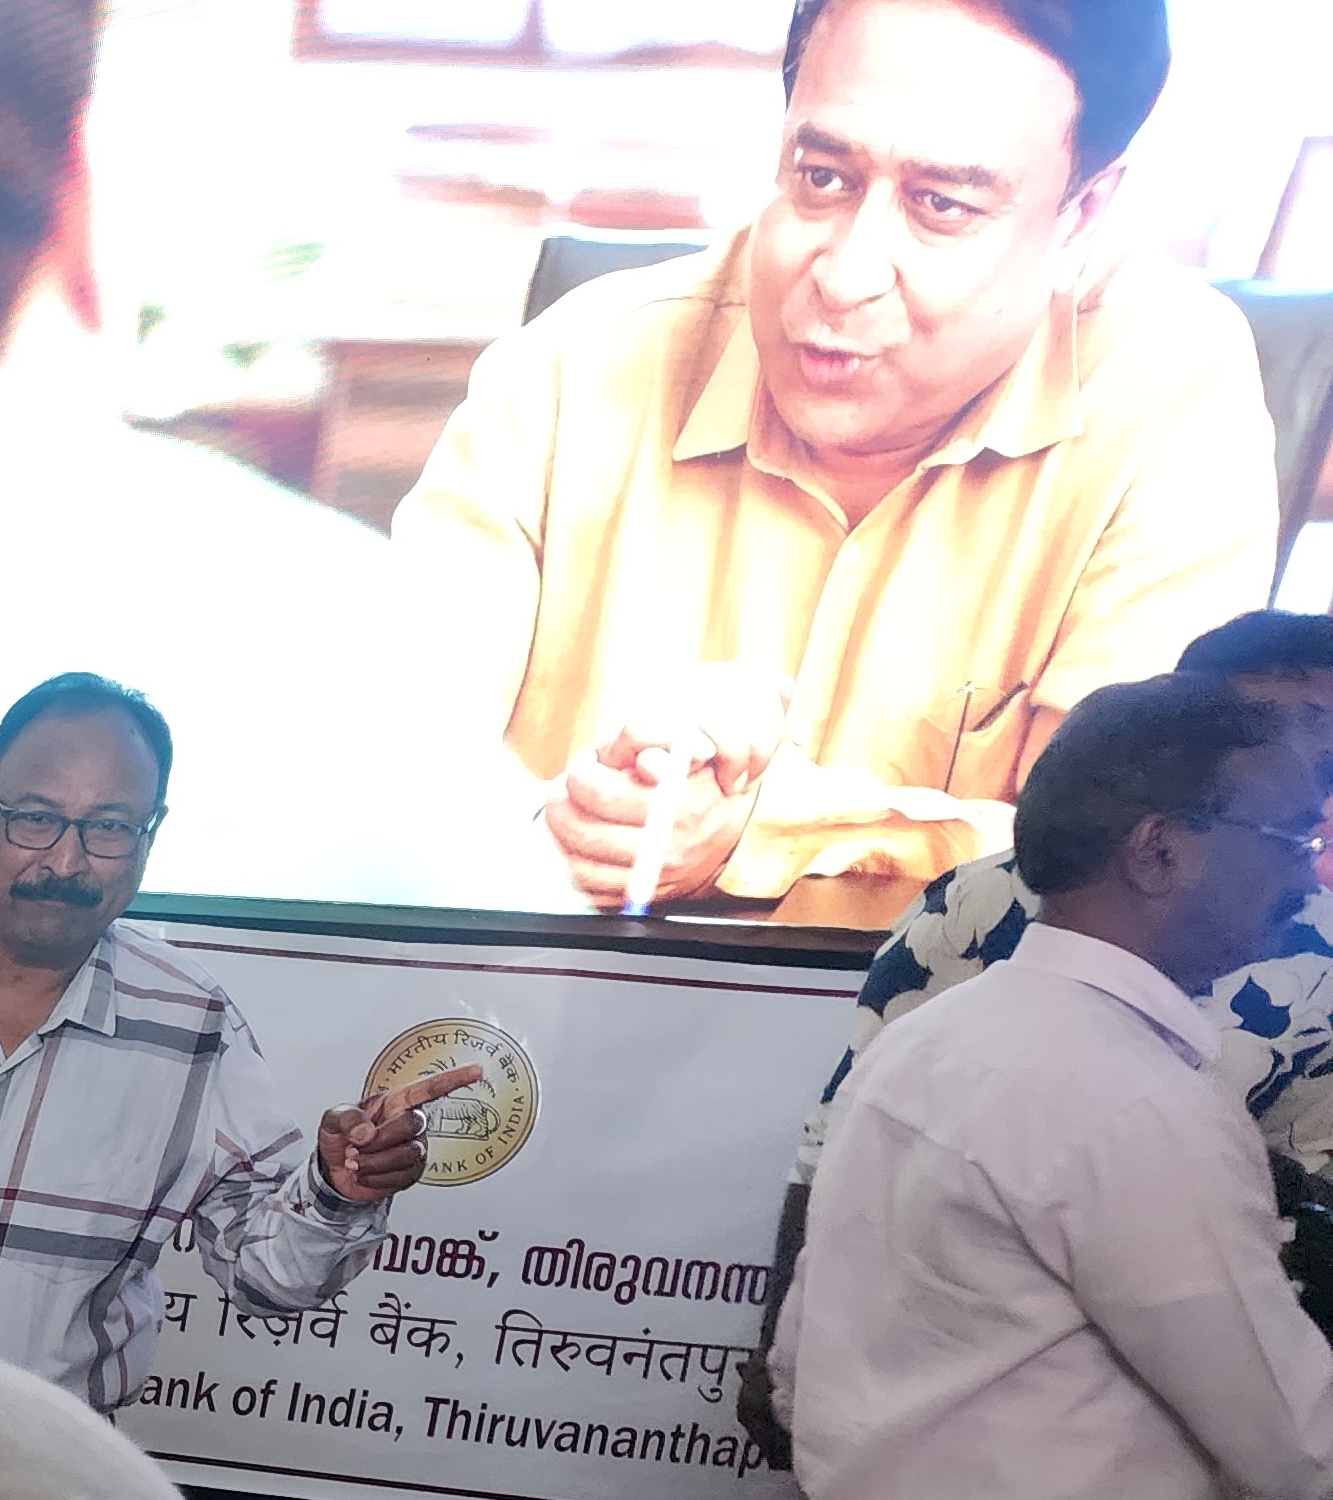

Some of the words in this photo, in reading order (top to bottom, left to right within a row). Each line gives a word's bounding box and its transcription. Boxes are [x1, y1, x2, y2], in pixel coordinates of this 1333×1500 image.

[427, 1159, 468, 1173] ANK
[475, 1146, 495, 1165] OF
[497, 1095, 524, 1145] INDIA
[369, 1292, 464, 1370] बैंक,
[494, 1309, 751, 1403] तिरुवनंतपु
[139, 1371, 220, 1413] ank
[233, 1379, 278, 1419] of
[287, 1381, 404, 1443] India,
[424, 1396, 763, 1479] Thiruvananthap
